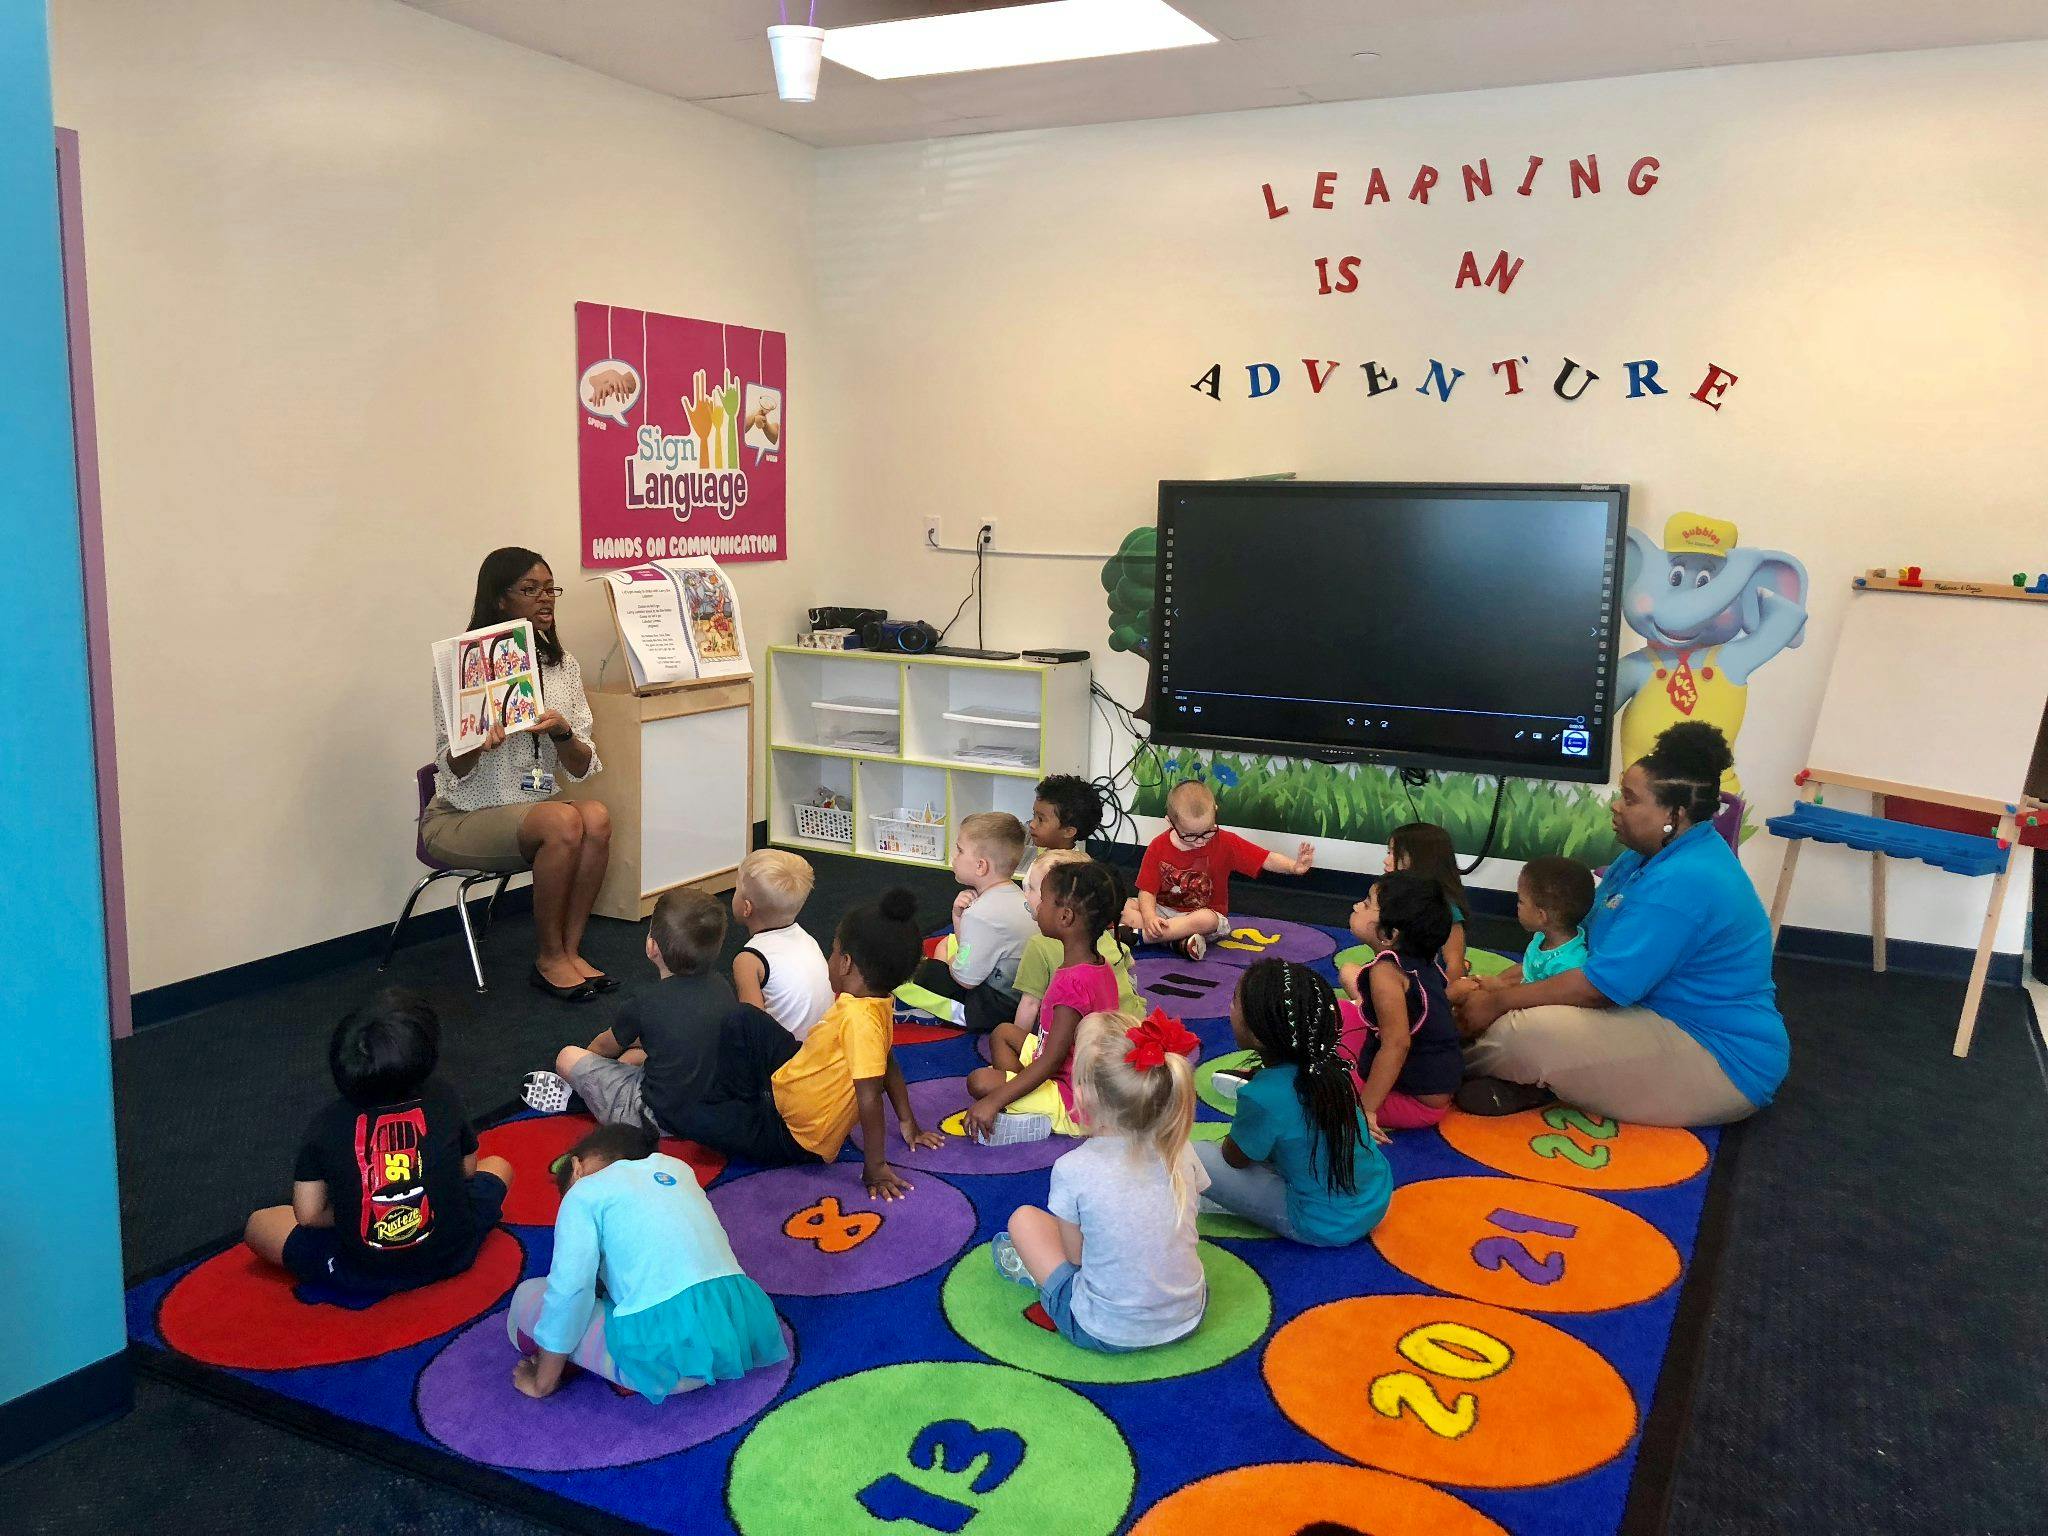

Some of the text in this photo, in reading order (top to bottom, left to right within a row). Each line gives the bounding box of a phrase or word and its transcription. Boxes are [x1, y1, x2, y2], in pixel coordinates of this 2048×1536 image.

[1261, 154, 1660, 219] LEARNING
[1314, 250, 1524, 295] IS AN
[1191, 355, 1738, 412] ADVENTURE
[640, 427, 697, 471] Sign
[627, 459, 746, 518] Language
[593, 534, 777, 560] HANDS ON COMMUNICATION
[1682, 526, 1720, 544] Bubbles
[1528, 1106, 1619, 1170] 22
[384, 1153, 411, 1182] 95
[783, 1197, 883, 1253] 8
[1470, 1207, 1580, 1285] 21
[1369, 1321, 1514, 1439] 20
[855, 1418, 1028, 1533] 13
